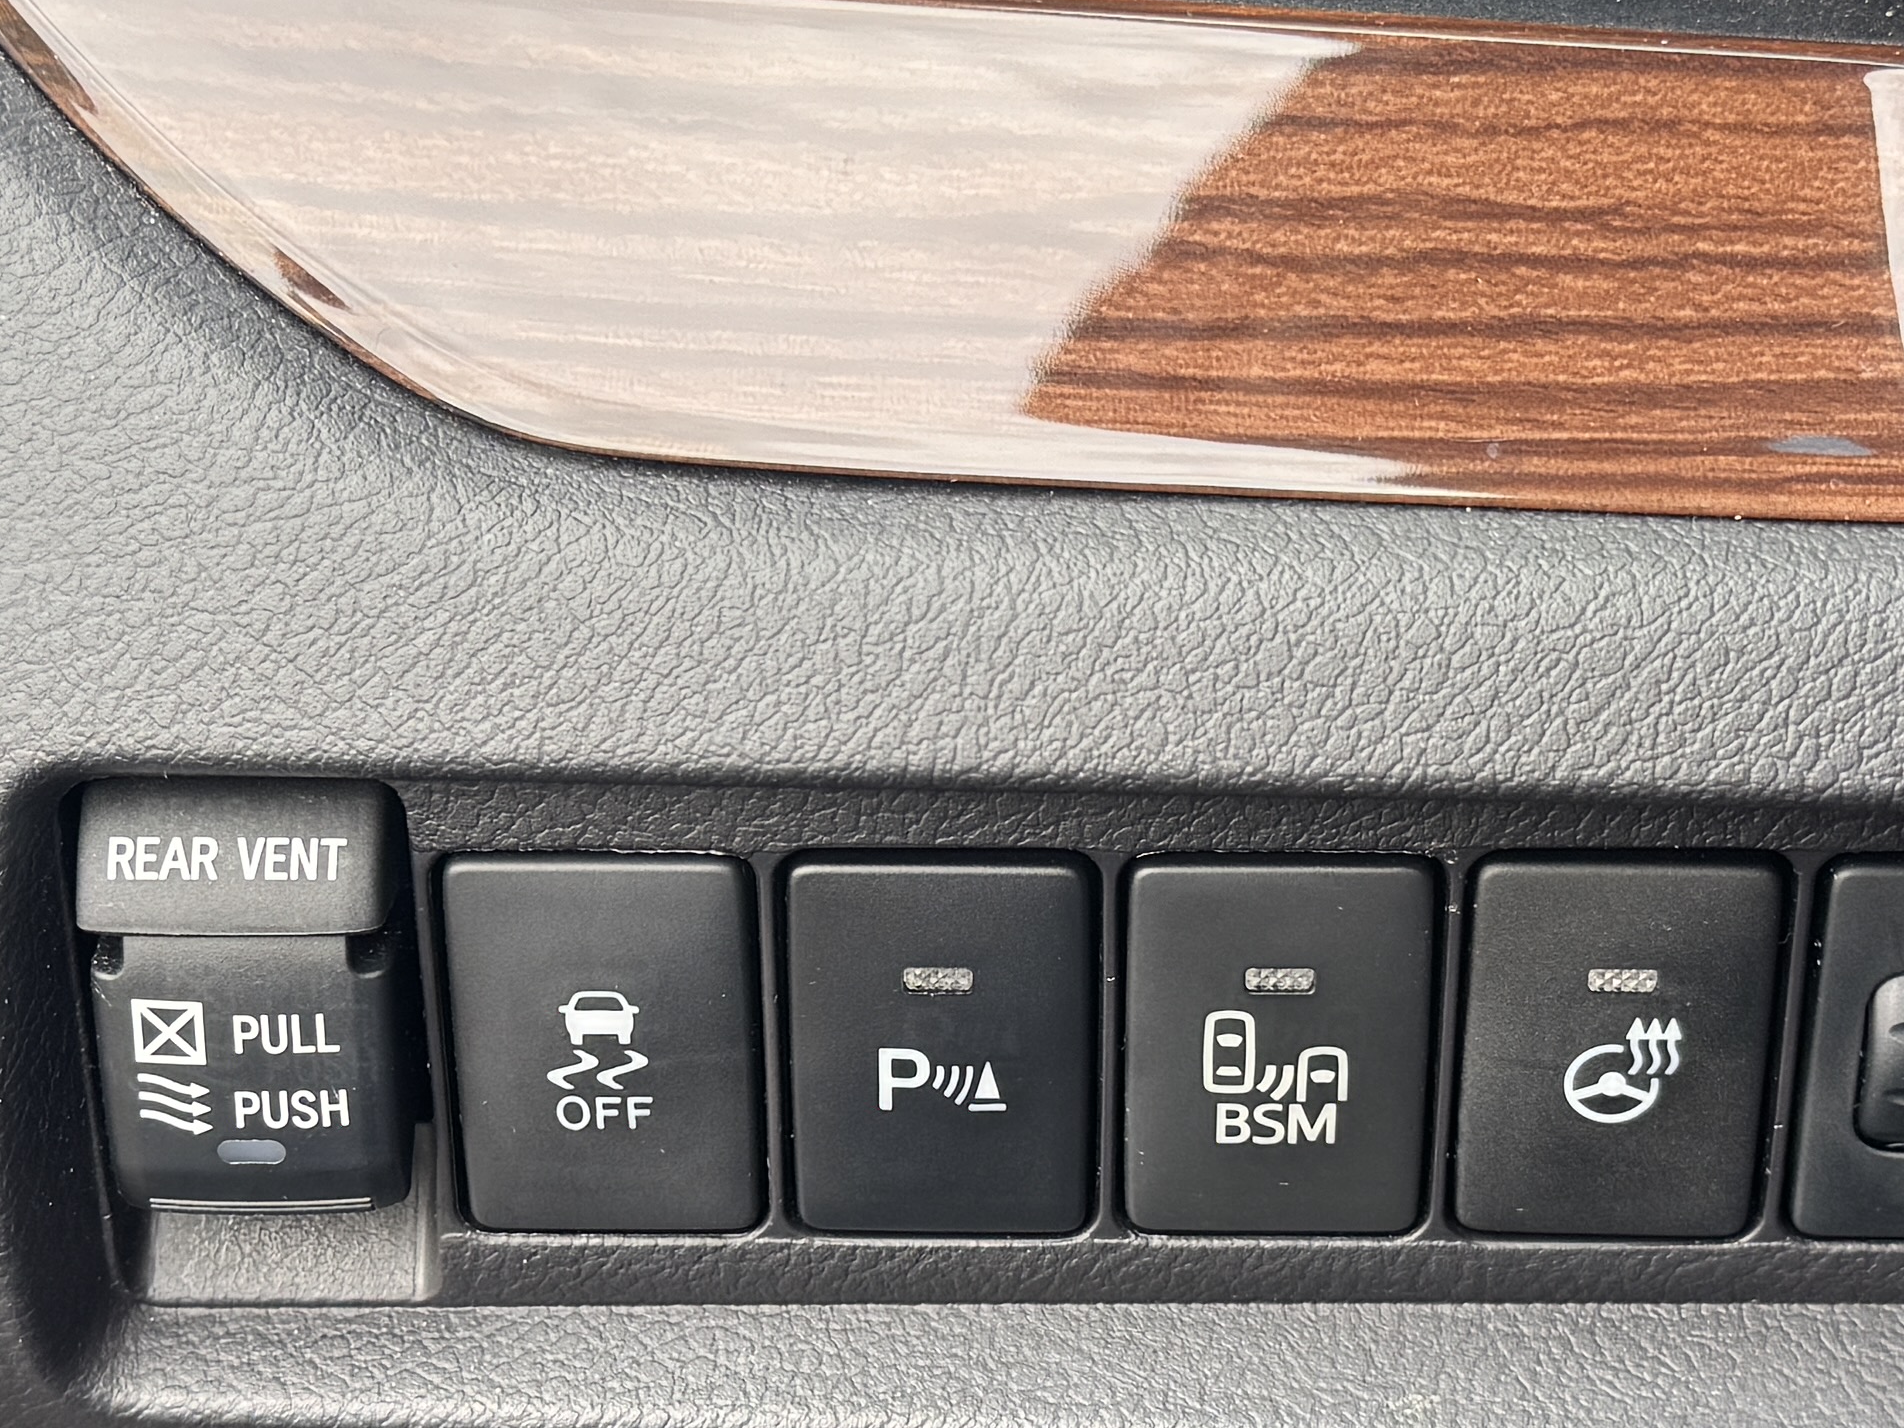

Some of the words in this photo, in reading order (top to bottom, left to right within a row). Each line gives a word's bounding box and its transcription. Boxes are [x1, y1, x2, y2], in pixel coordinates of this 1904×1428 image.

[106, 836, 219, 881] REAR
[236, 837, 348, 882] VENT
[232, 1014, 341, 1055] PULL
[878, 1047, 932, 1111] P
[235, 1090, 351, 1128] PUSH
[556, 1095, 653, 1131] OFF
[1215, 1103, 1336, 1145] BSM
